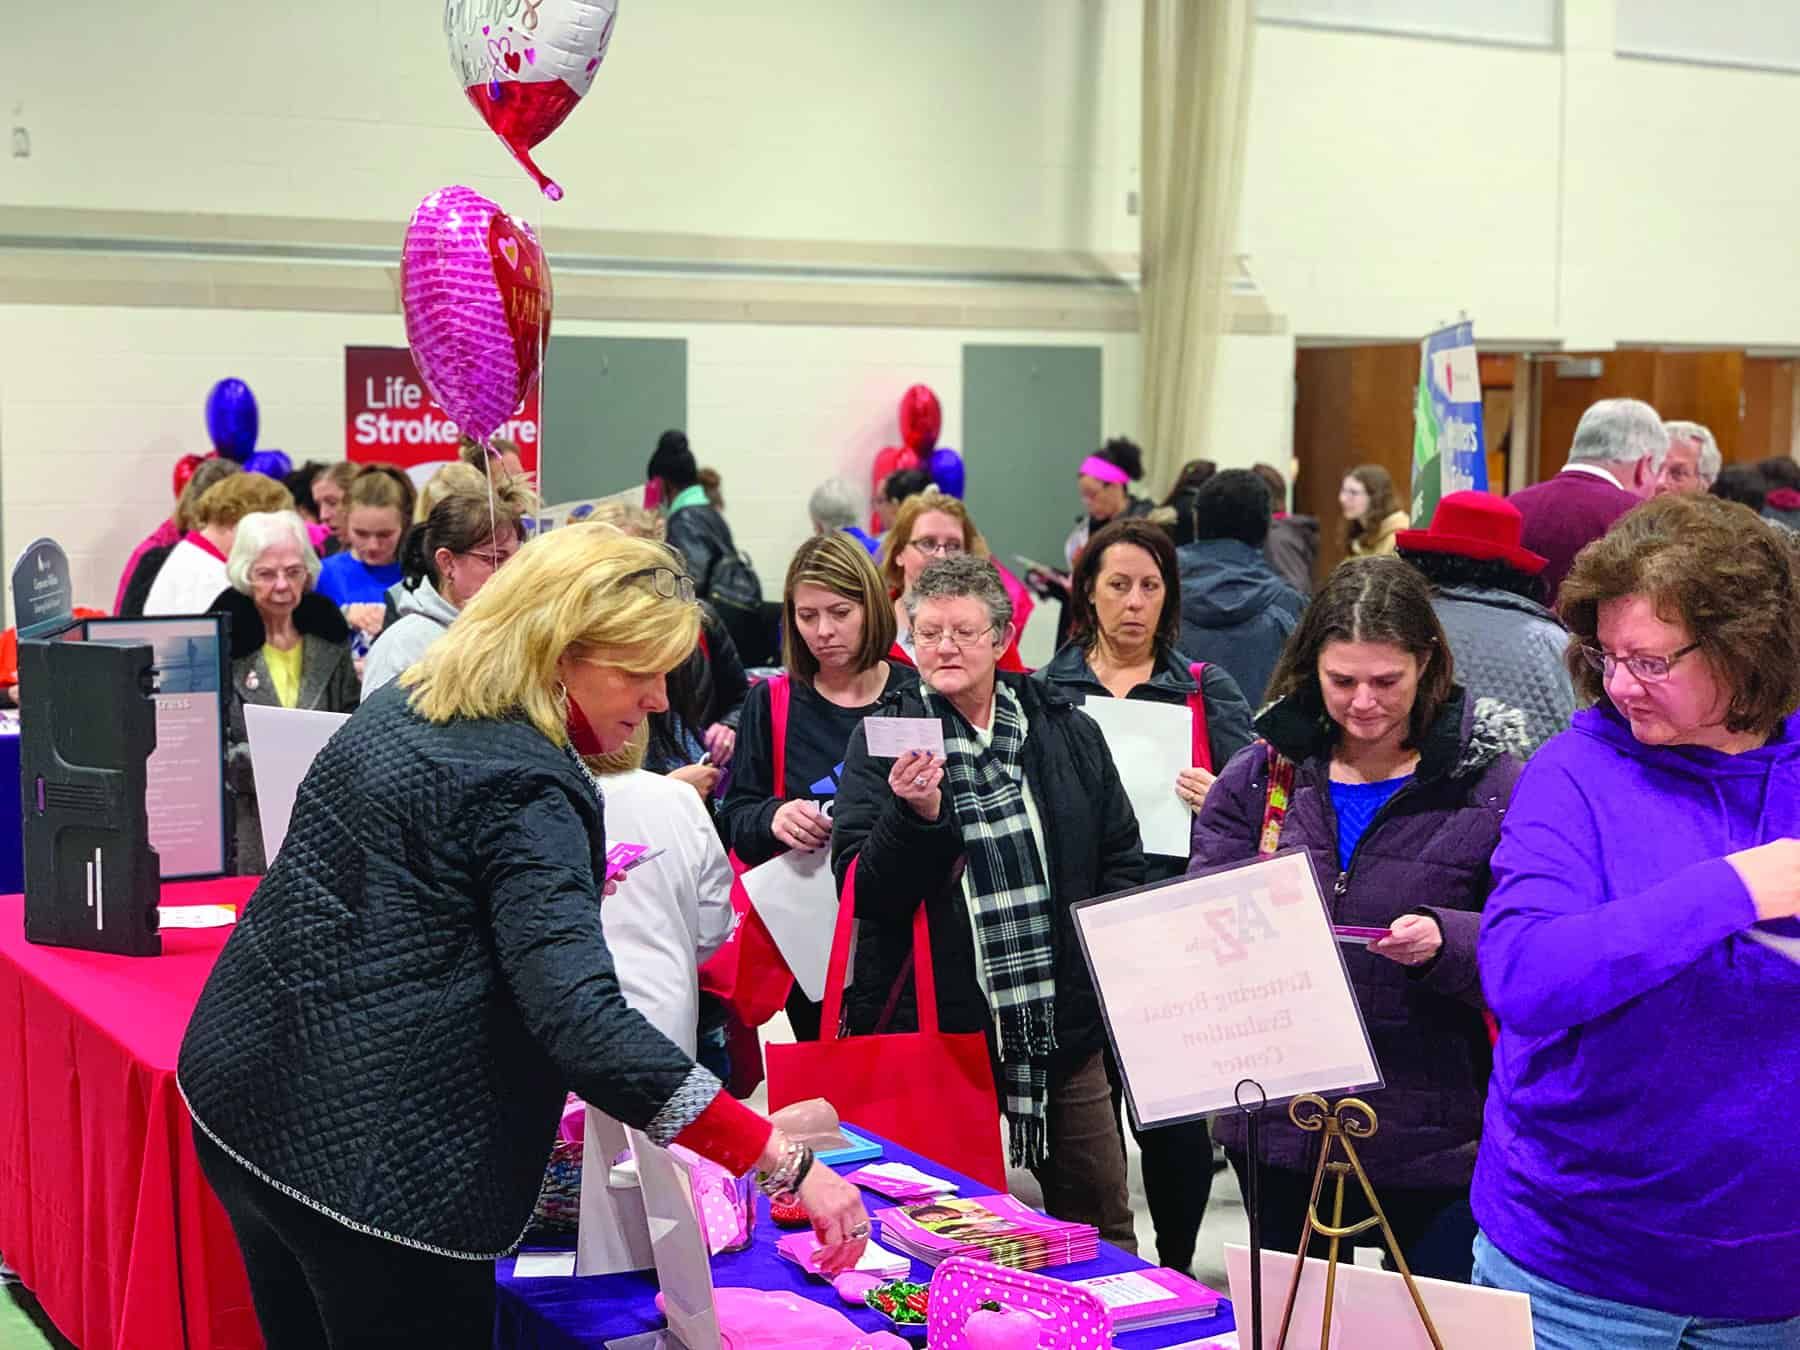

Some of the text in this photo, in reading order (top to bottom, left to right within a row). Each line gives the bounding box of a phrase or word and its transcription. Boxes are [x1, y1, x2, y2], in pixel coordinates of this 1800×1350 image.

[366, 376, 422, 409] Life
[355, 413, 537, 444] Stroke are
